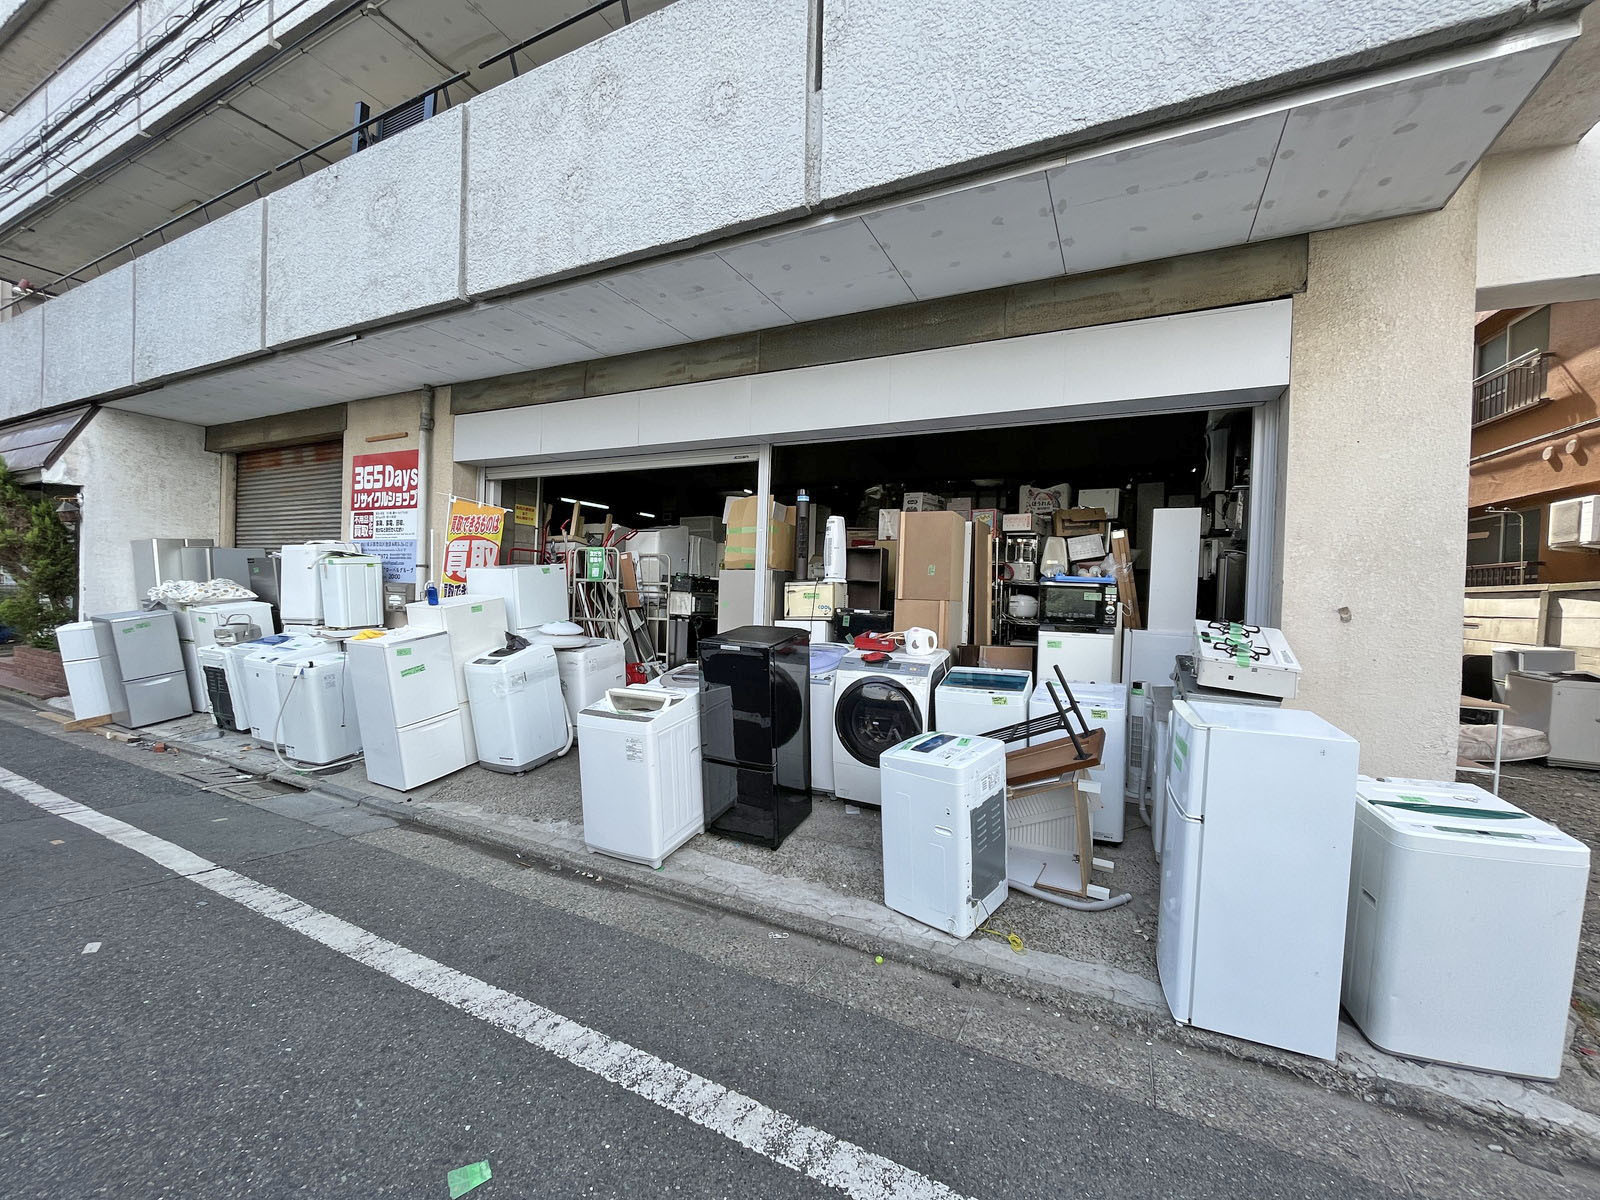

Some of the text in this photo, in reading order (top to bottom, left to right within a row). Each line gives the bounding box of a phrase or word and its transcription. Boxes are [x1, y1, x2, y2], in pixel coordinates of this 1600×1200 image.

[354, 465, 418, 491] 365 Days
[353, 489, 417, 508] リサイクルショップ
[353, 525, 369, 538] 買取
[450, 514, 500, 533] 買取できるものは
[446, 539, 499, 578] 買取
